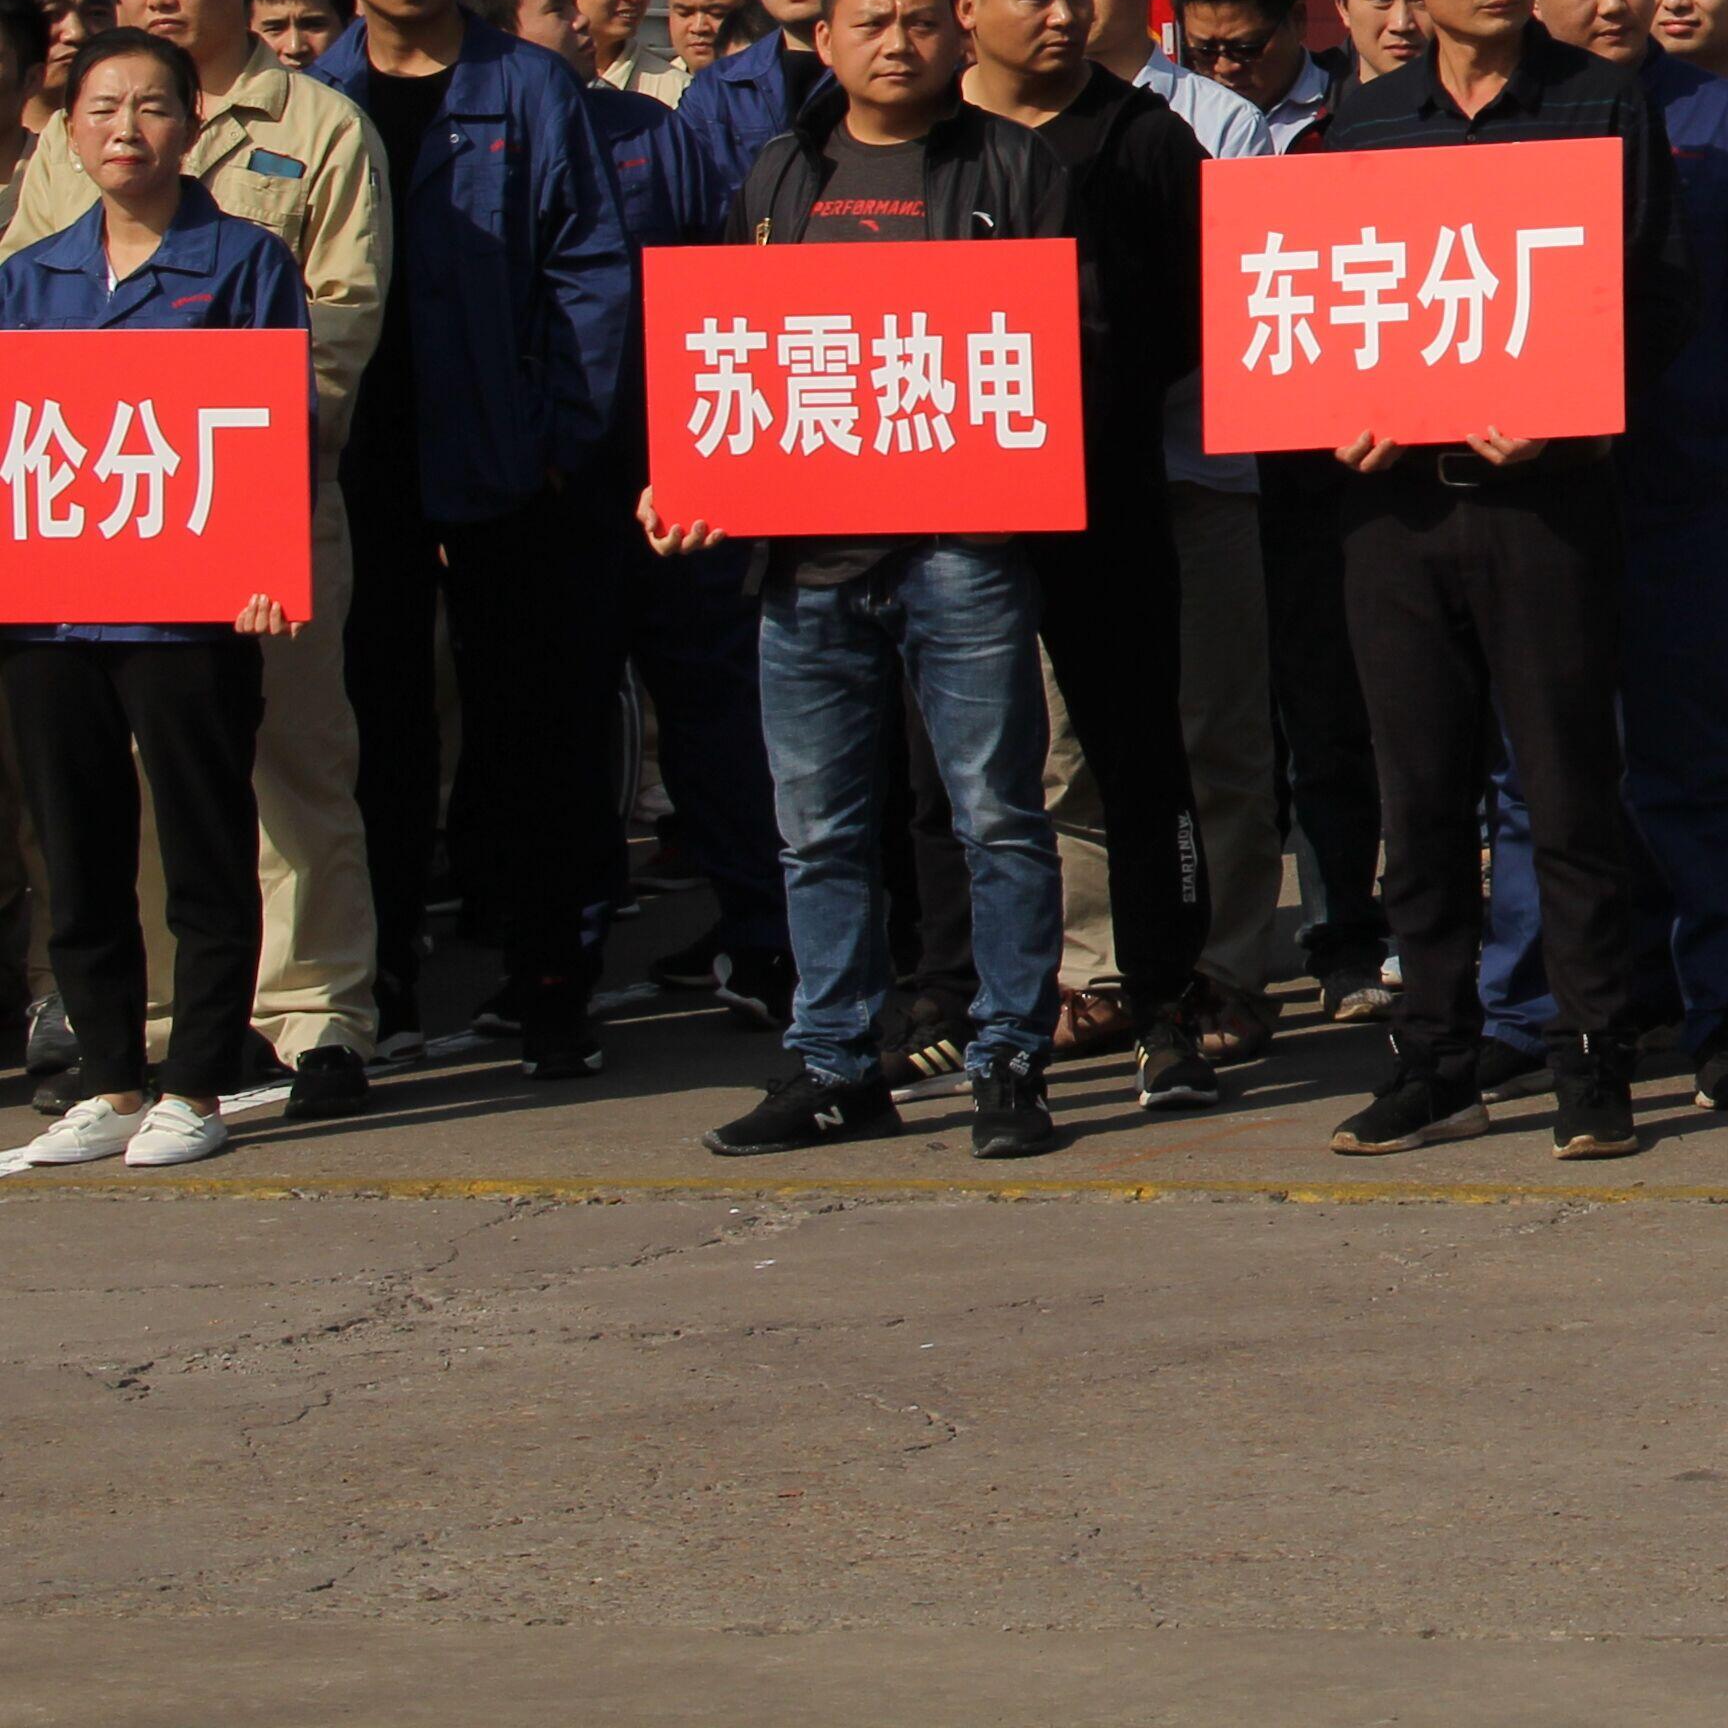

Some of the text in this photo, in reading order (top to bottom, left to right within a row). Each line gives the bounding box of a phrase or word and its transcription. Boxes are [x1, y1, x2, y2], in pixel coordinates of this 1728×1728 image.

[1241, 223, 1584, 375] 东宇分厂
[686, 312, 1046, 457] 苏震热电
[0, 399, 270, 541] 伦分厂
